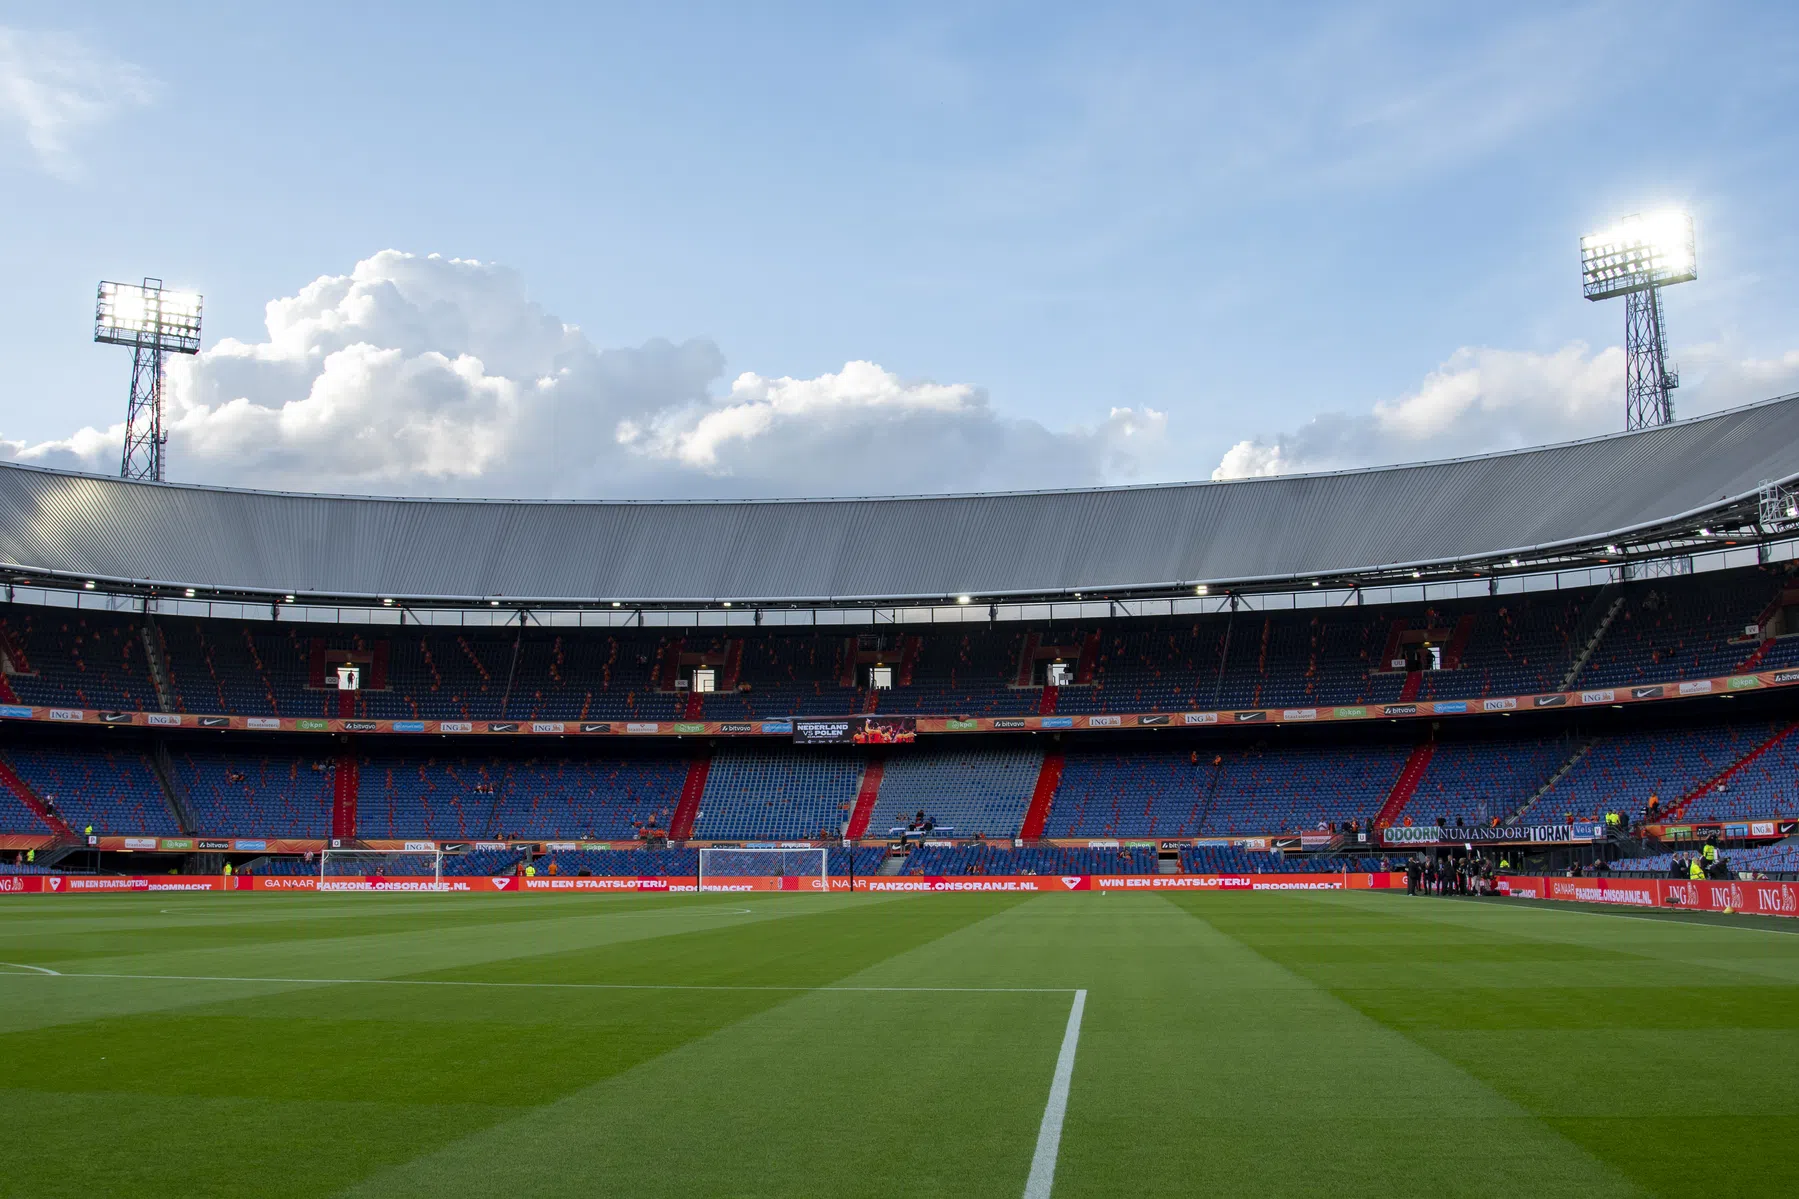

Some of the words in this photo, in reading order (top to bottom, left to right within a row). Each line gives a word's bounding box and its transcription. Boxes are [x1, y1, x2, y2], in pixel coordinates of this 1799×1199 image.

[1740, 678, 1754, 687] kpn
[1583, 694, 1601, 703] ING
[1392, 706, 1416, 715] bitvavo
[1485, 702, 1503, 710] ING
[51, 711, 69, 720] ING
[1347, 708, 1361, 716] kpn
[149, 715, 167, 724] ING
[1090, 718, 1108, 726] ING
[1186, 714, 1204, 722] ING
[534, 724, 552, 732] ING
[1385, 827, 1439, 841] ODOORN
[1439, 826, 1530, 841] NUMANSDORP
[1531, 826, 1570, 841] TORAN
[1753, 826, 1765, 834] ING
[0, 880, 11, 890] NG
[70, 880, 84, 888] WIN
[264, 879, 282, 888] GA
[283, 879, 315, 888] NAAR
[526, 880, 550, 888] WIN
[552, 880, 577, 888] EEN
[577, 880, 667, 888] STAATSLOTERIJ
[869, 882, 1038, 890] FANZONE.ONSORANJE.NL
[1099, 879, 1125, 887] WIN
[1126, 879, 1152, 887] EEN
[1152, 878, 1250, 887] STAATSLOTERIJ
[1669, 886, 1687, 905] ING
[1711, 887, 1731, 908] ING
[1757, 888, 1781, 910] ING
